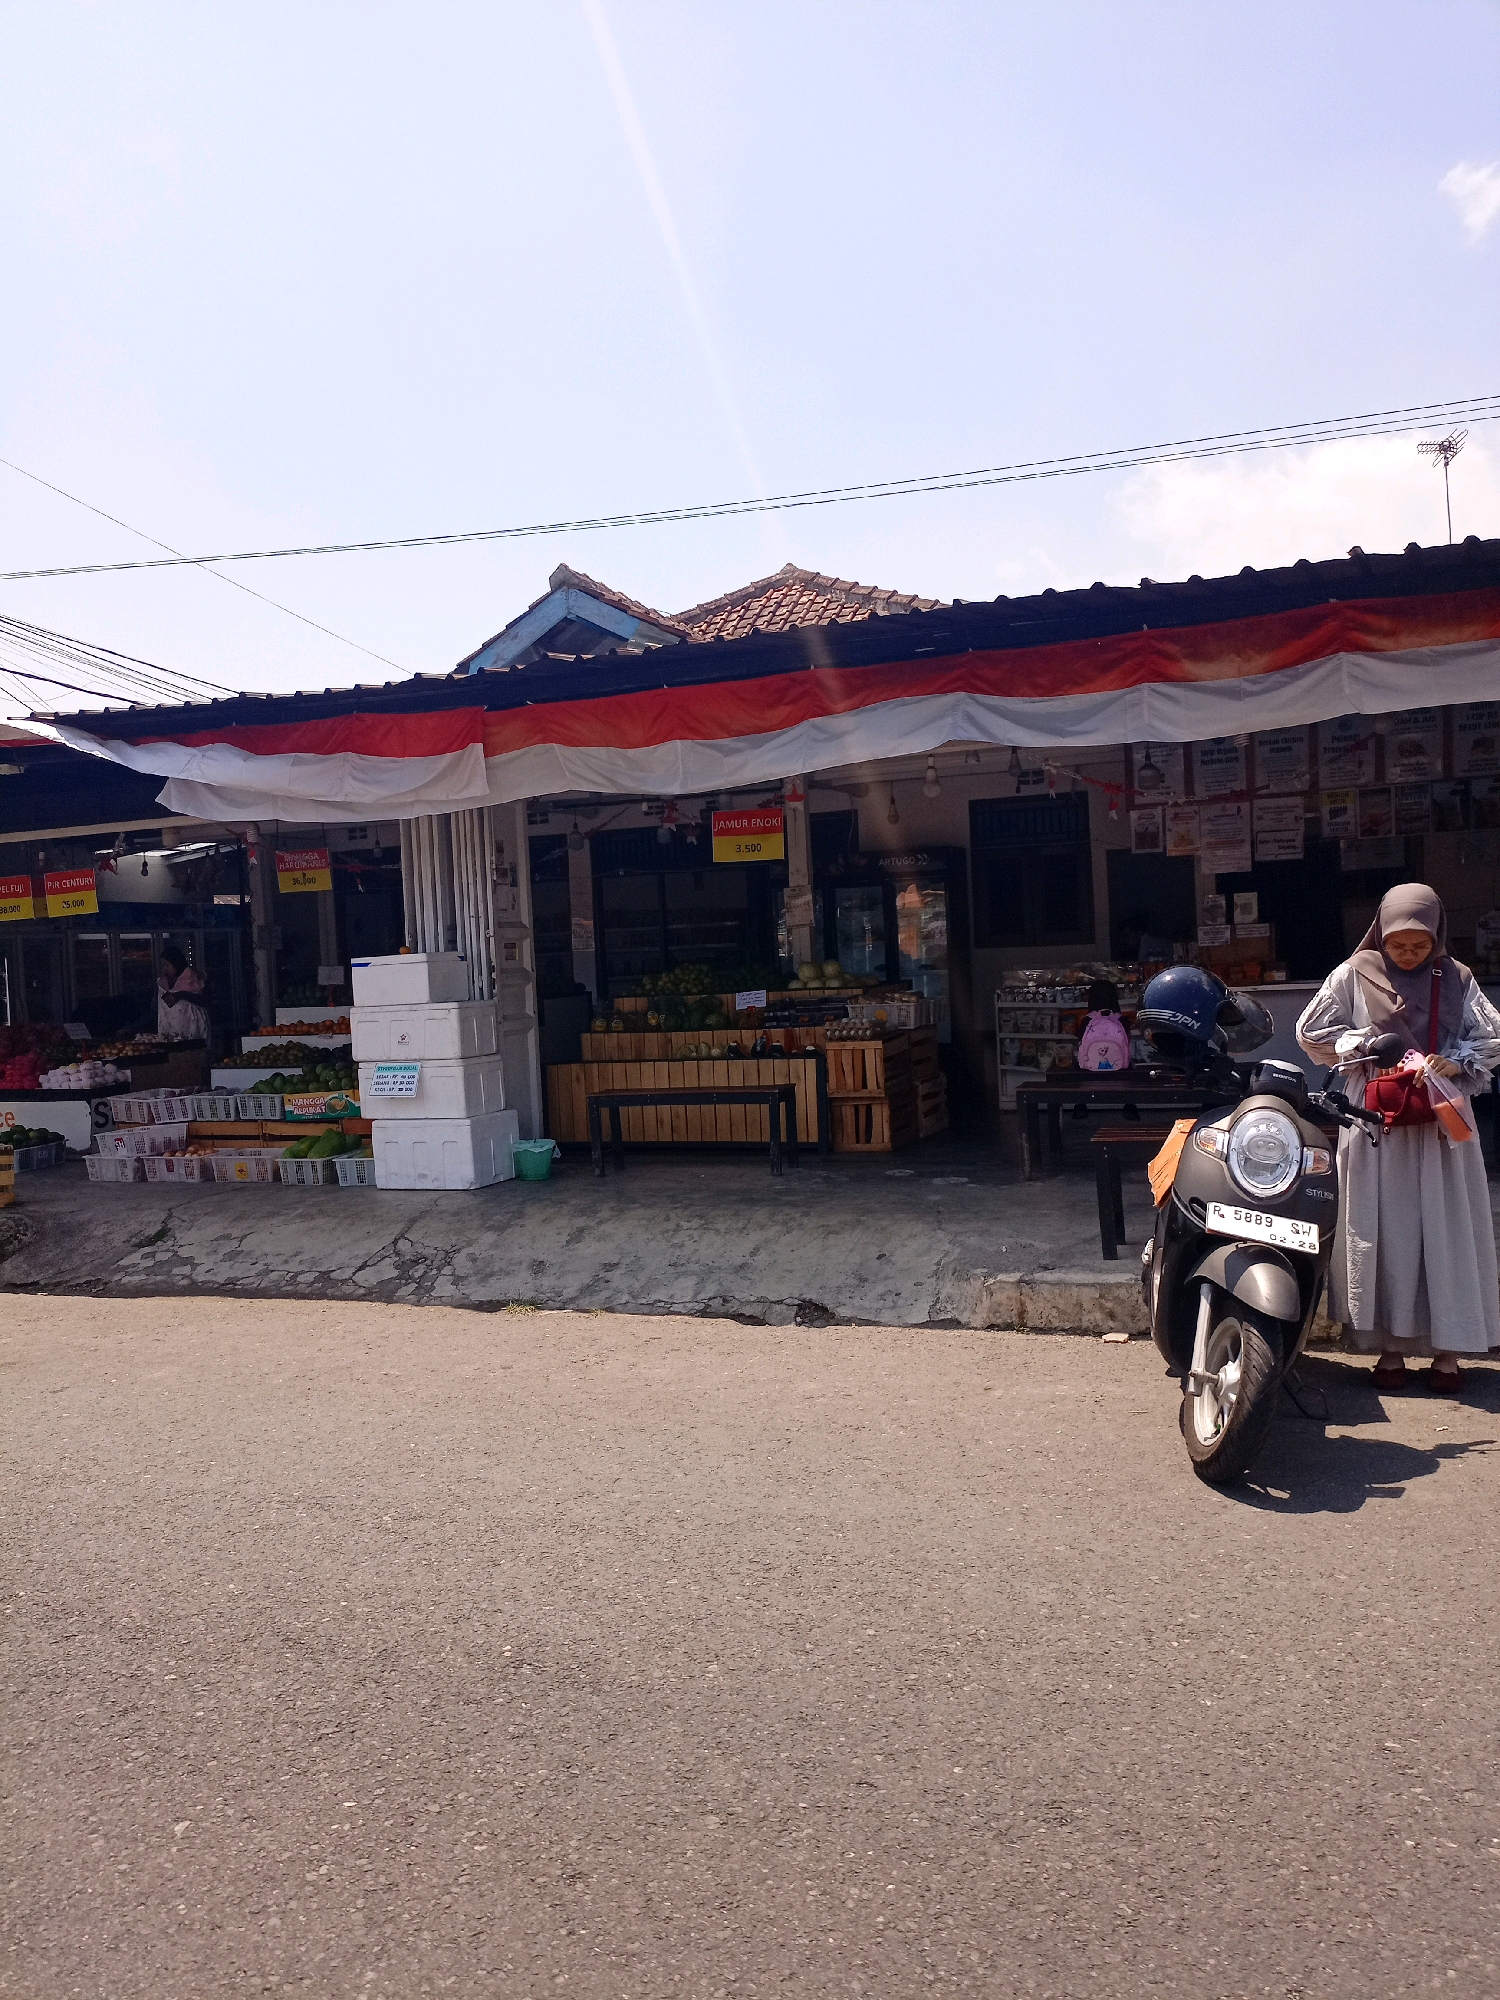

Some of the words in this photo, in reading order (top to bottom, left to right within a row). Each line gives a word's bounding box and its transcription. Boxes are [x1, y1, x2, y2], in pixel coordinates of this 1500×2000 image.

[714, 817, 749, 831] JAMUR
[751, 816, 782, 828] ENOKI
[735, 843, 762, 854] 3.500
[879, 855, 916, 867] ARTUGO
[47, 881, 60, 890] PIR
[61, 876, 94, 888] CENTURY
[0, 885, 10, 893] EL
[61, 899, 85, 909] 25.000
[1170, 1012, 1201, 1030] JPN
[1272, 1073, 1297, 1083] HONDA
[292, 1097, 325, 1106] MANGGA
[1213, 1205, 1222, 1216] R
[1233, 1209, 1273, 1228] 5889
[1290, 1222, 1312, 1237] SW
